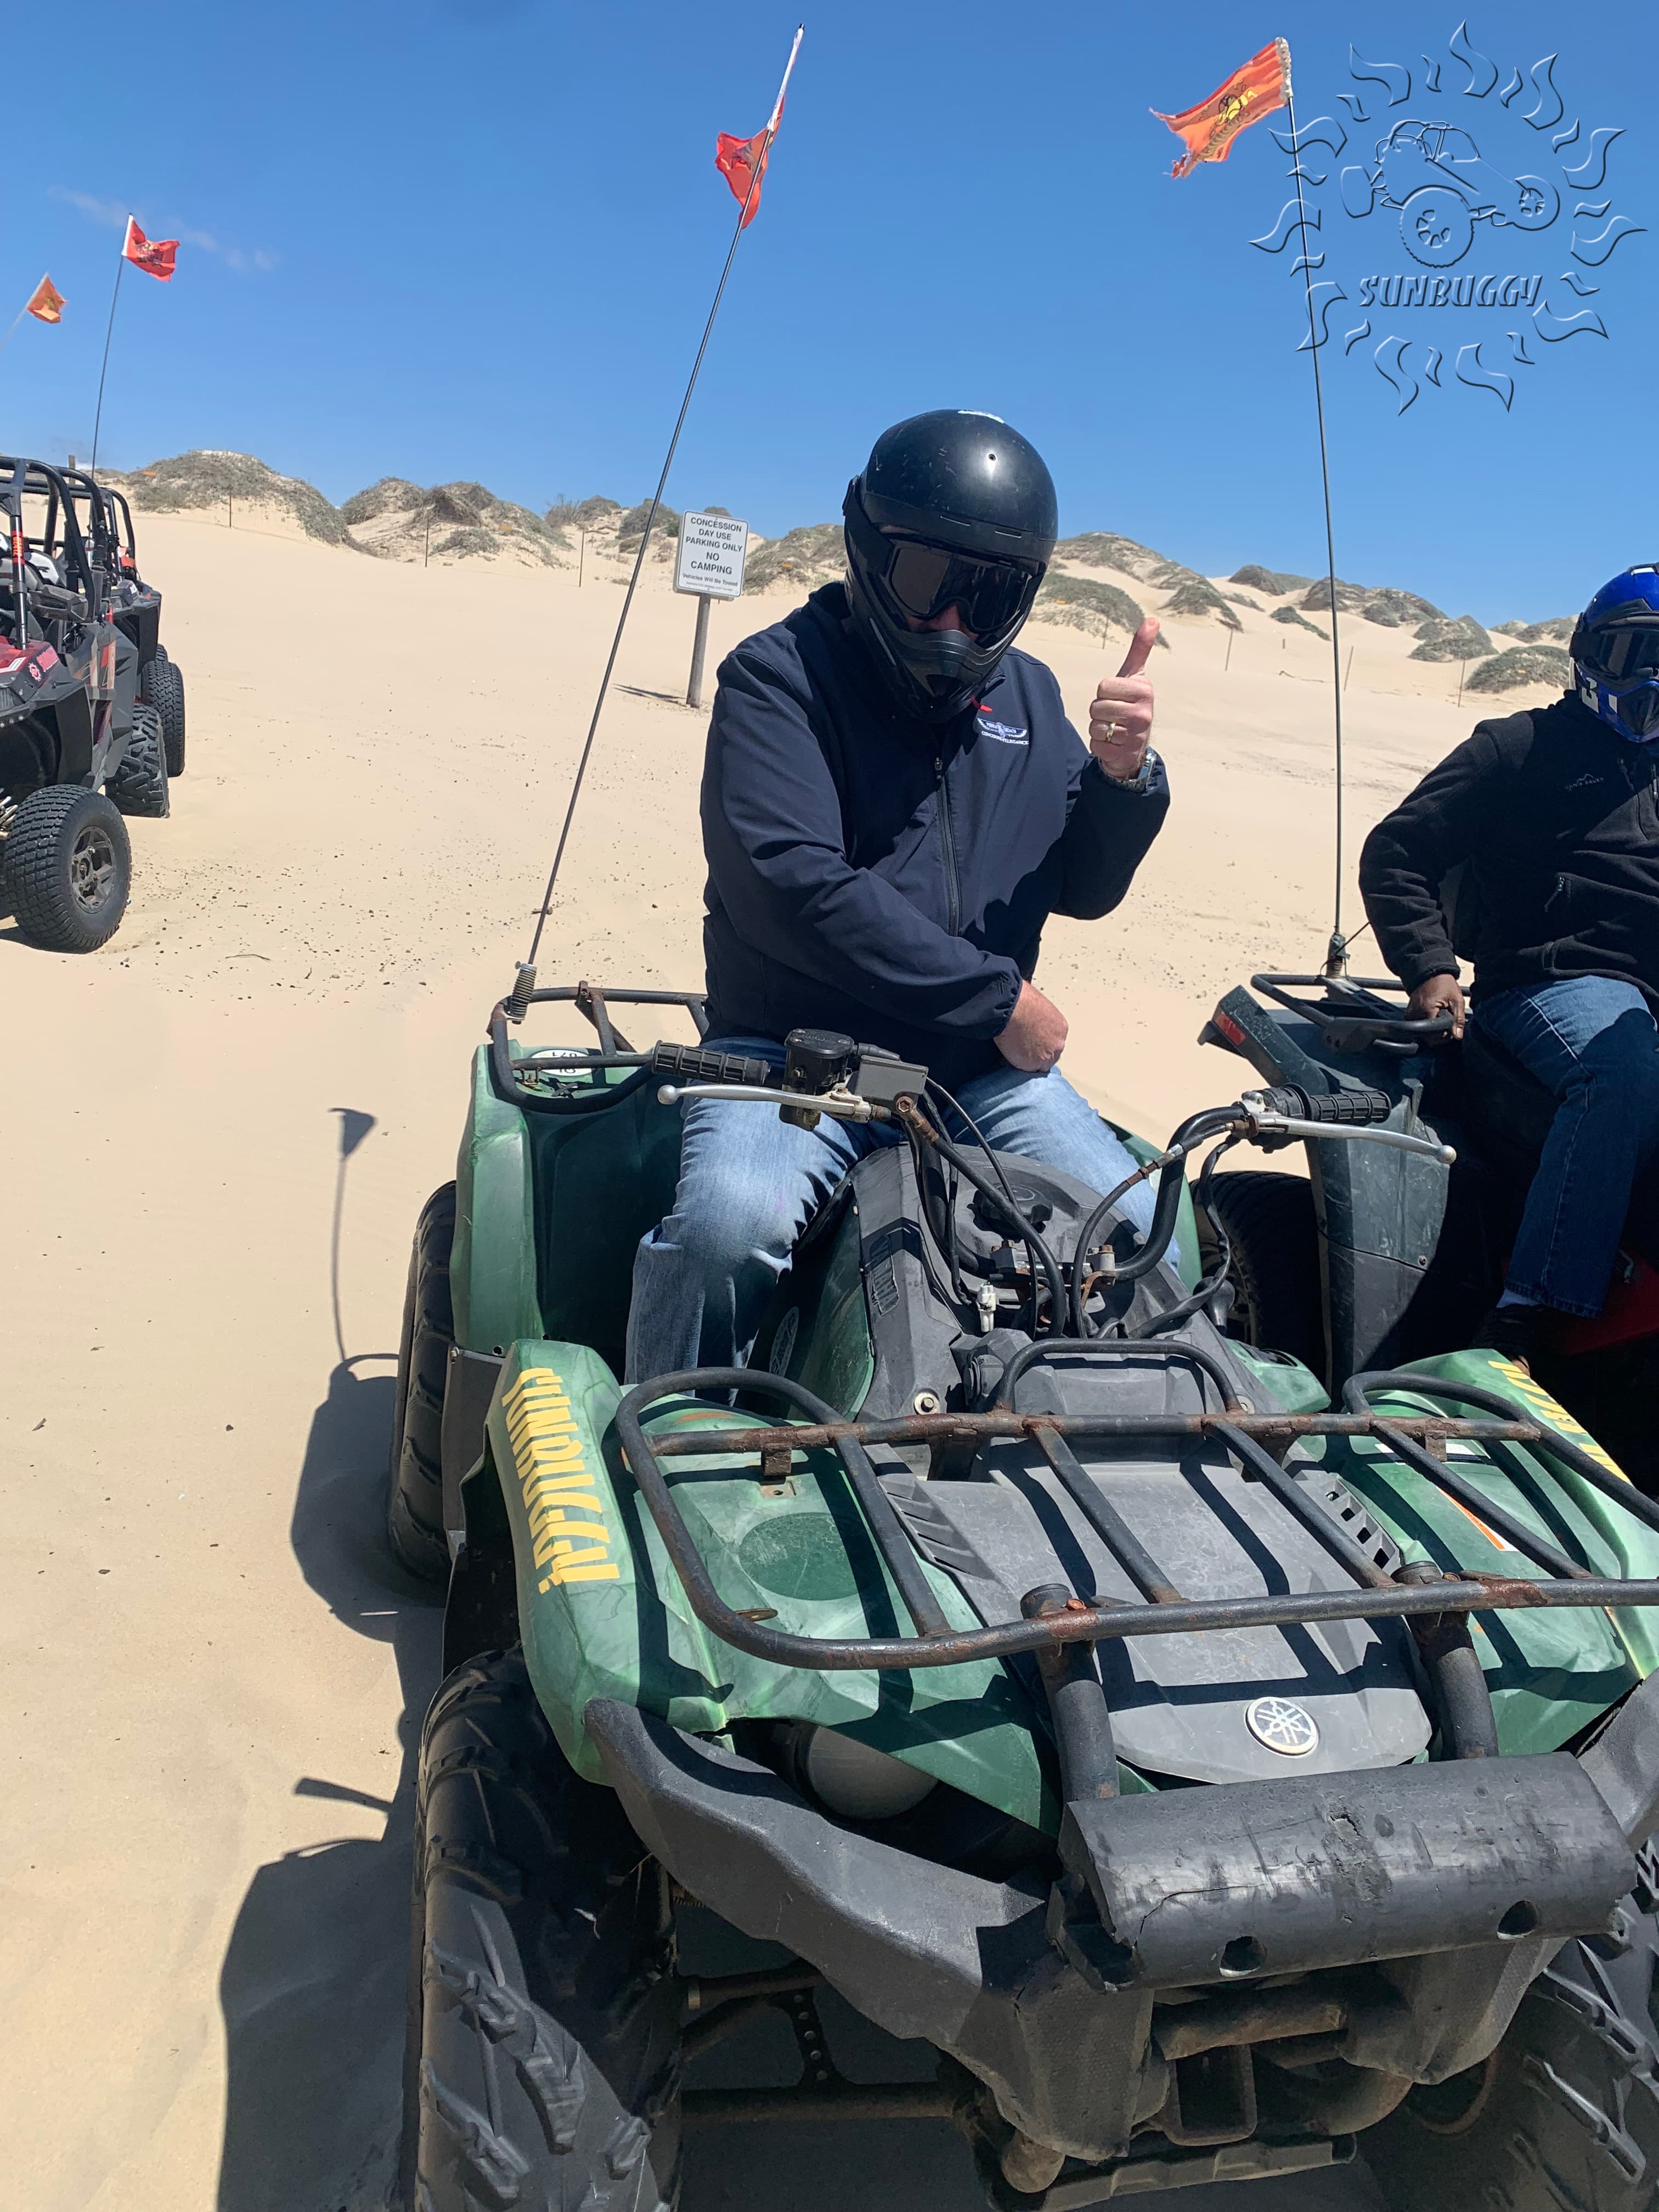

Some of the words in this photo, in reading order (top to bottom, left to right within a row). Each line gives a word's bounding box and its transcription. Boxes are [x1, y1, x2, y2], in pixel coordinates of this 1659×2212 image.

[691, 517, 742, 532] CONCESSION
[699, 528, 714, 537] DAY
[716, 532, 731, 540] USE
[686, 536, 720, 549] PARKING
[723, 543, 742, 552] ONLY
[706, 551, 719, 561] NO
[691, 561, 732, 574] CAMPING
[501, 1368, 619, 1594] SUNBUGGY
